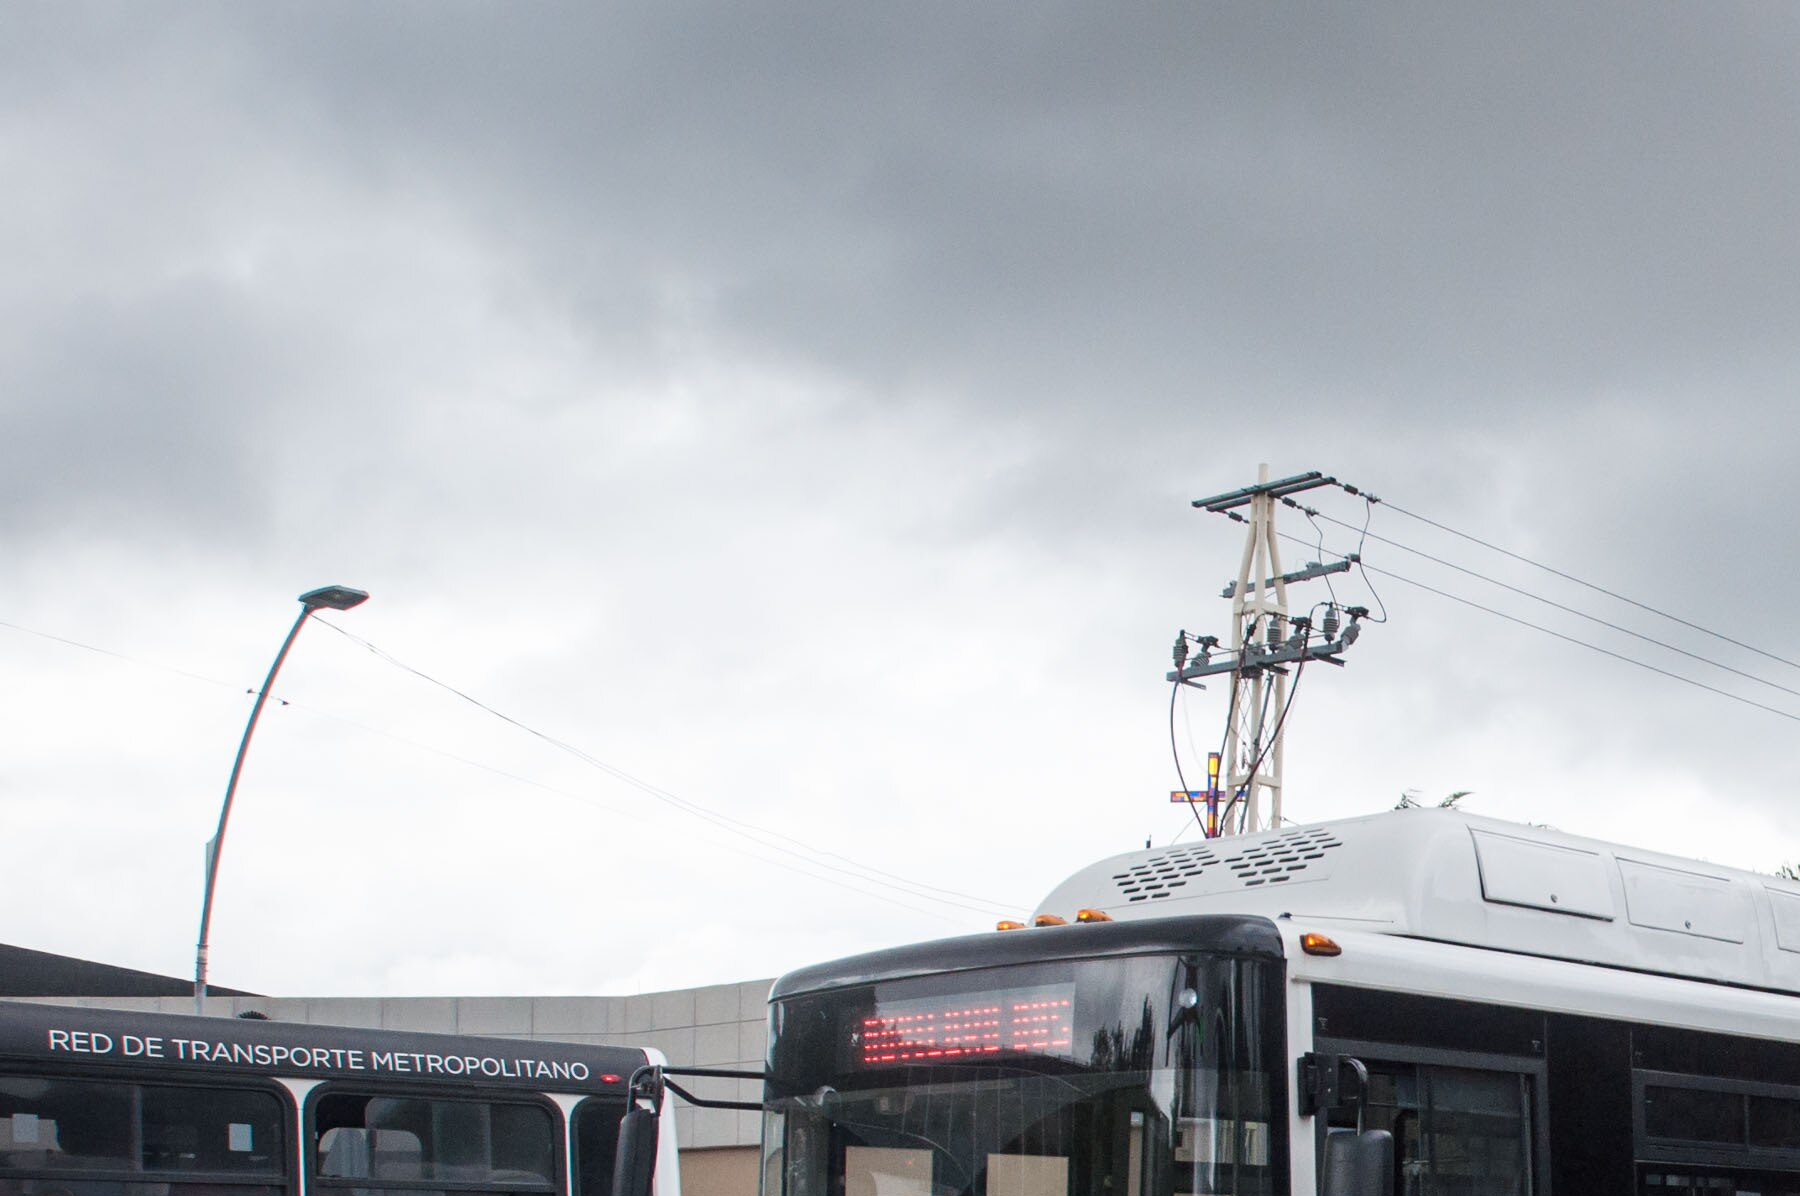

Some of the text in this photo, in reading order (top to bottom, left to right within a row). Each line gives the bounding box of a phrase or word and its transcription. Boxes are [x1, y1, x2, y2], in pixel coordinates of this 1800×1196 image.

[48, 1028, 590, 1082] RED DE TRANSPORTE METROPOLITANO
